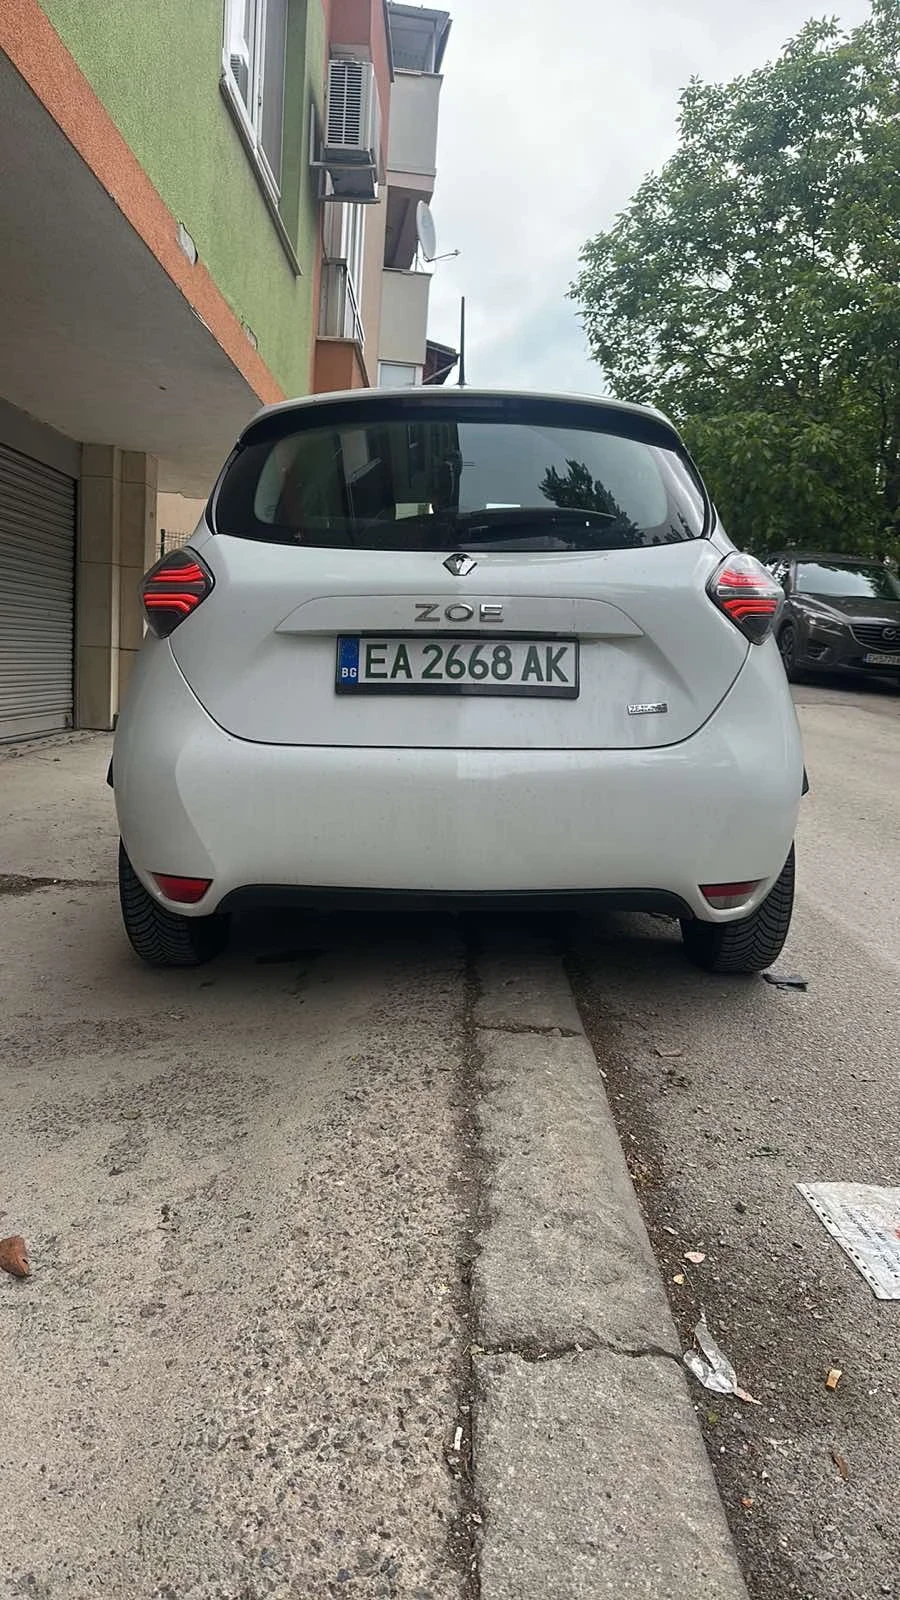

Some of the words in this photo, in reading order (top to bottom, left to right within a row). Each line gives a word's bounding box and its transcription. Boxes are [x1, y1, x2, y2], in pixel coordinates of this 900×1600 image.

[414, 603, 504, 623] ZOE
[341, 667, 357, 679] BG
[365, 643, 412, 680] EA
[421, 643, 513, 681] 2668
[521, 645, 569, 683] AK
